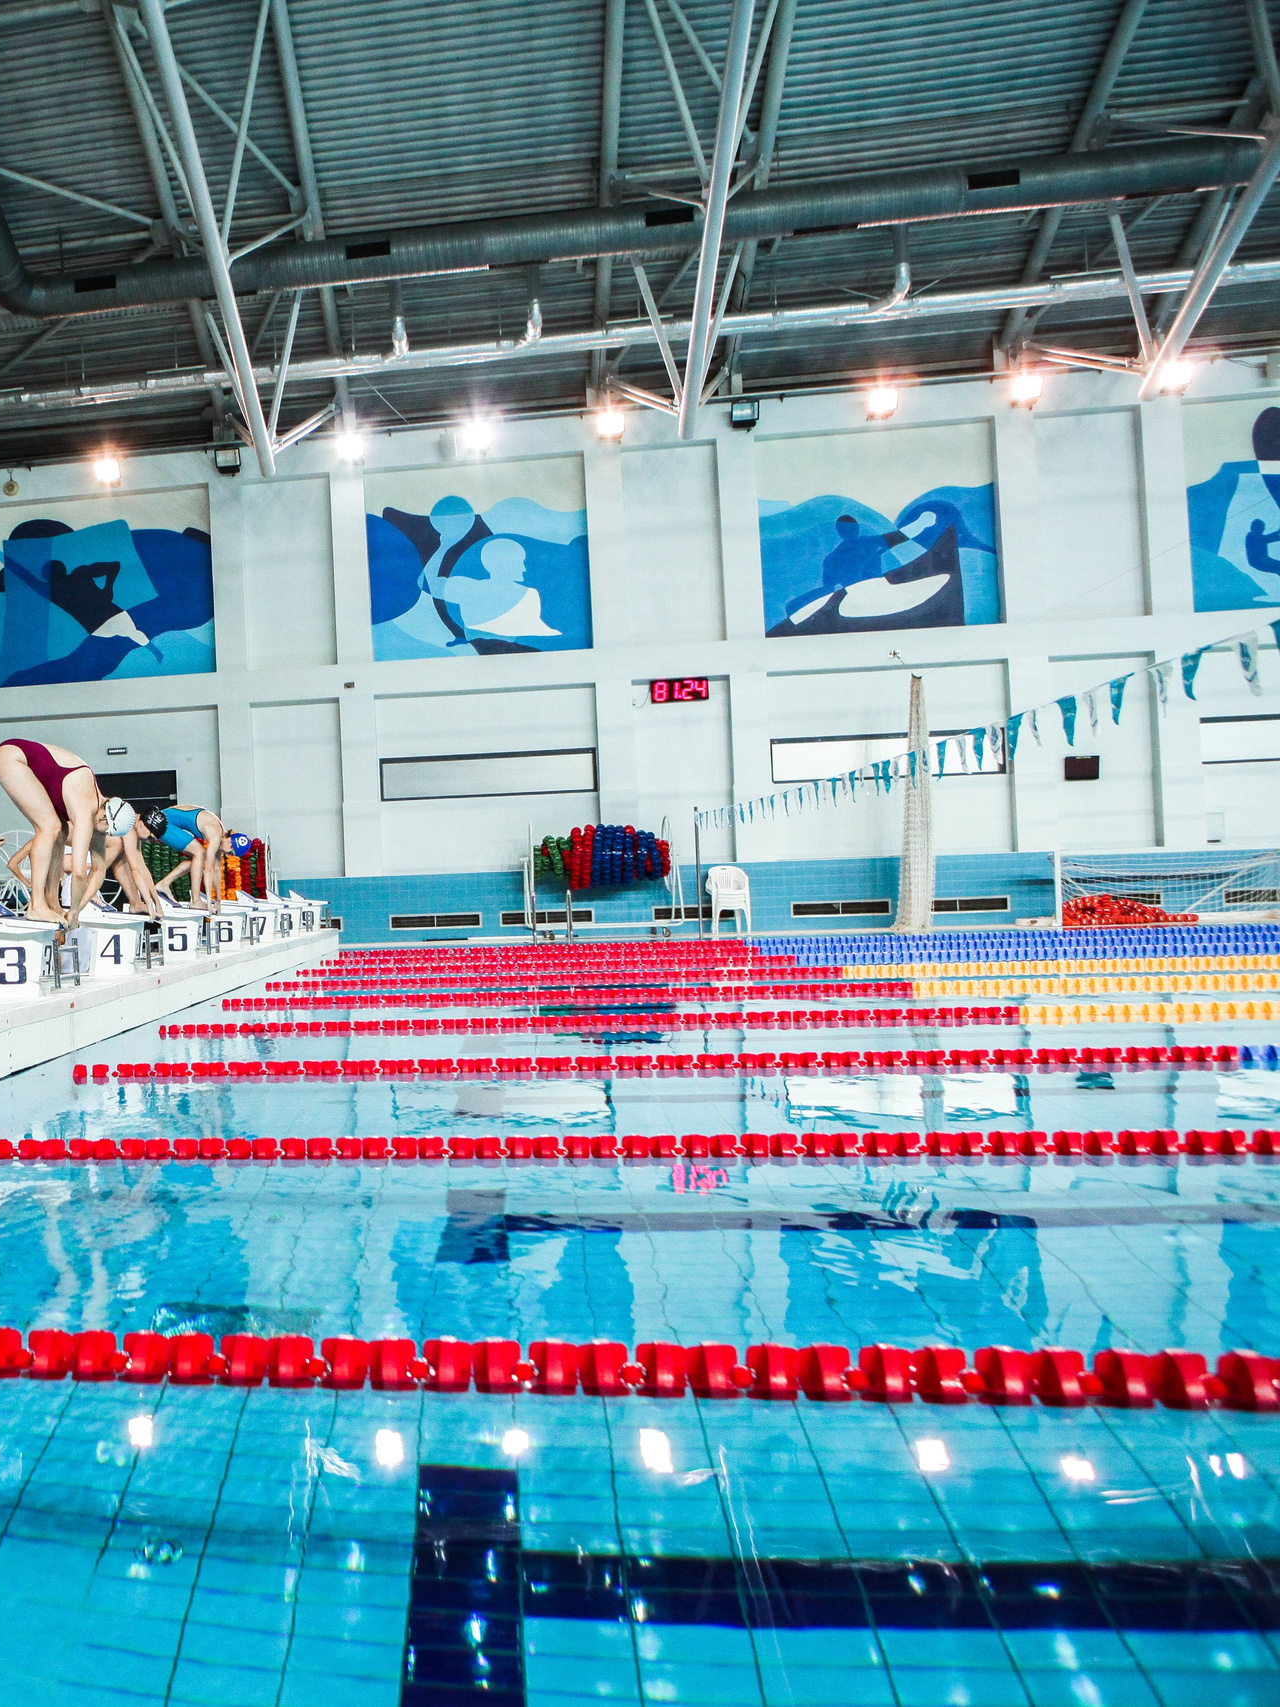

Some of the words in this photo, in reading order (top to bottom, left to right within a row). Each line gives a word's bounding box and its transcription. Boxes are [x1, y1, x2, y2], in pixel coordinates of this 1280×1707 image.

[168, 926, 187, 951] 5
[215, 920, 233, 942] 6
[100, 934, 123, 964] 4
